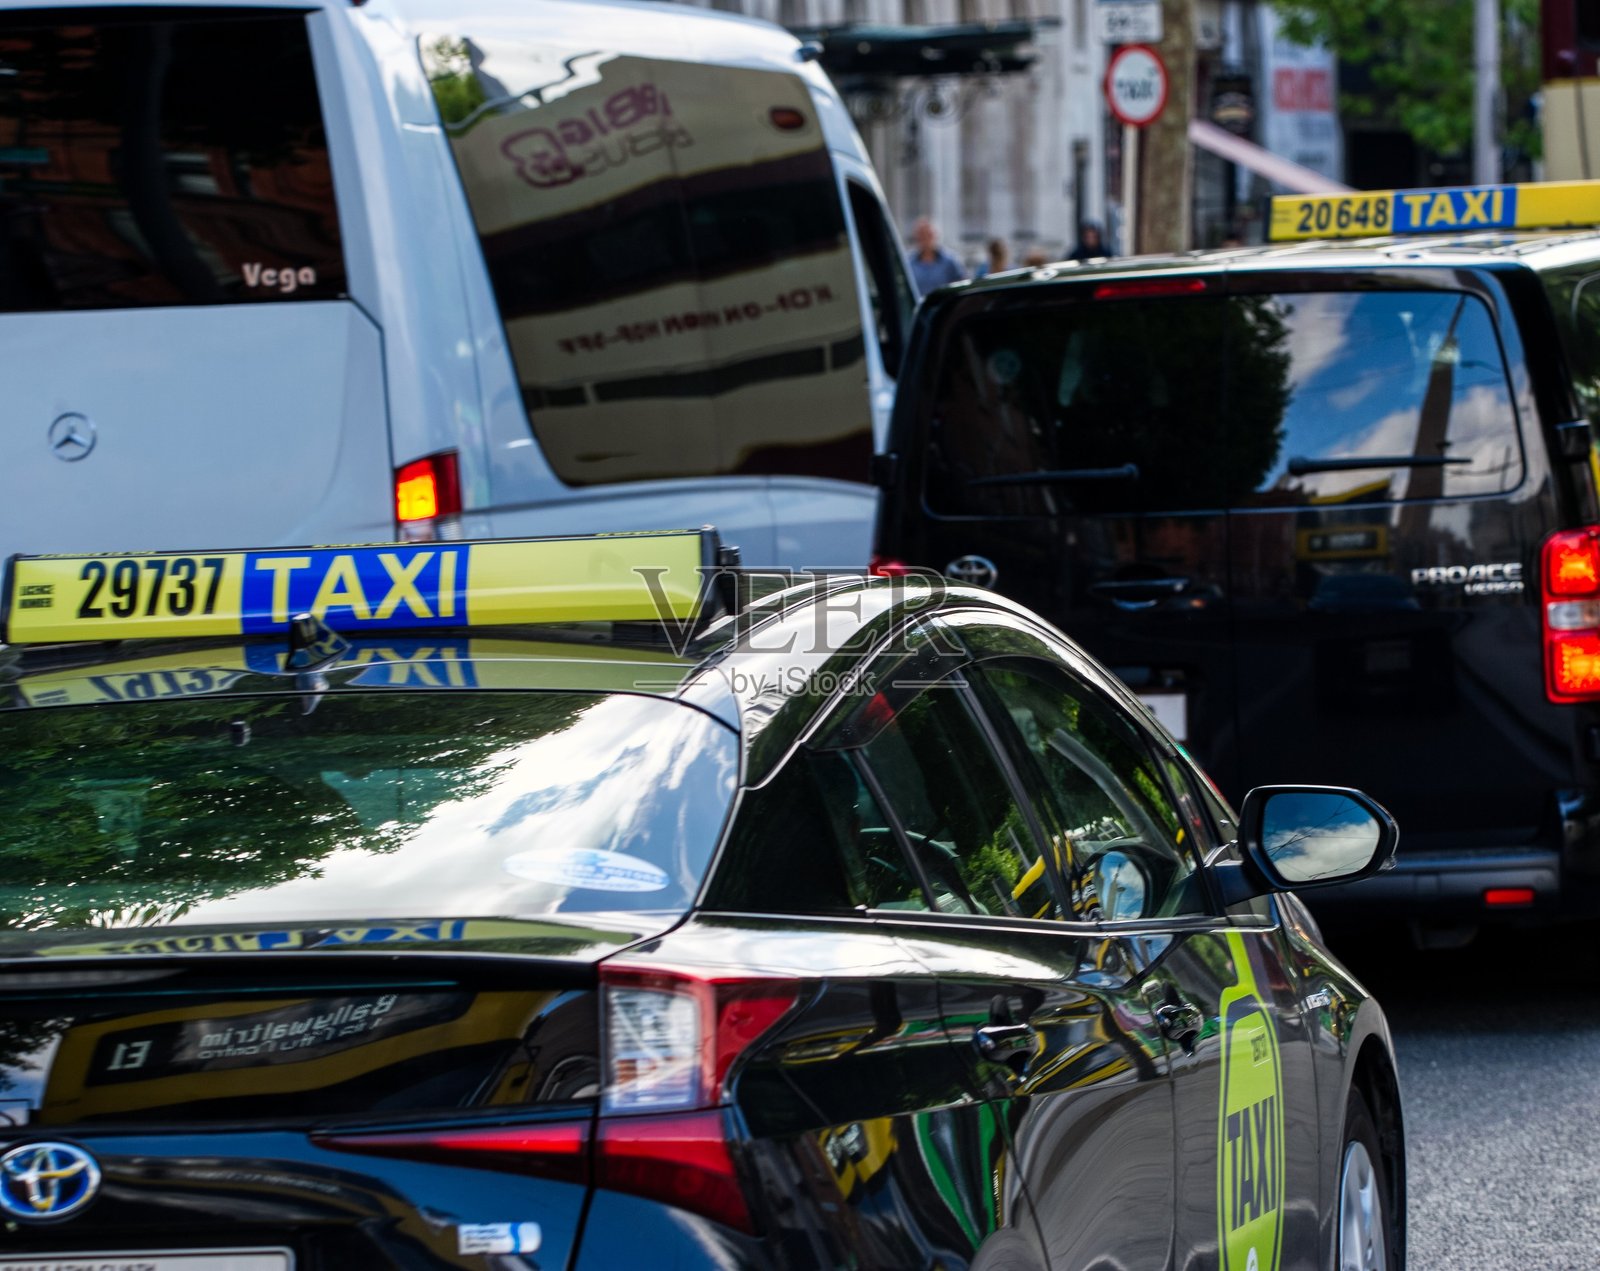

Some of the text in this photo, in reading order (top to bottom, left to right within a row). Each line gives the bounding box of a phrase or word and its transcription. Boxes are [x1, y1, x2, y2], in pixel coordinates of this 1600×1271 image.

[1297, 198, 1389, 232] 20648
[1403, 190, 1504, 227] TAXI
[242, 262, 317, 293] Vega
[77, 551, 458, 623] 29737 TAXI
[1411, 562, 1523, 584] PROACE
[1227, 1095, 1276, 1232] TAXI
